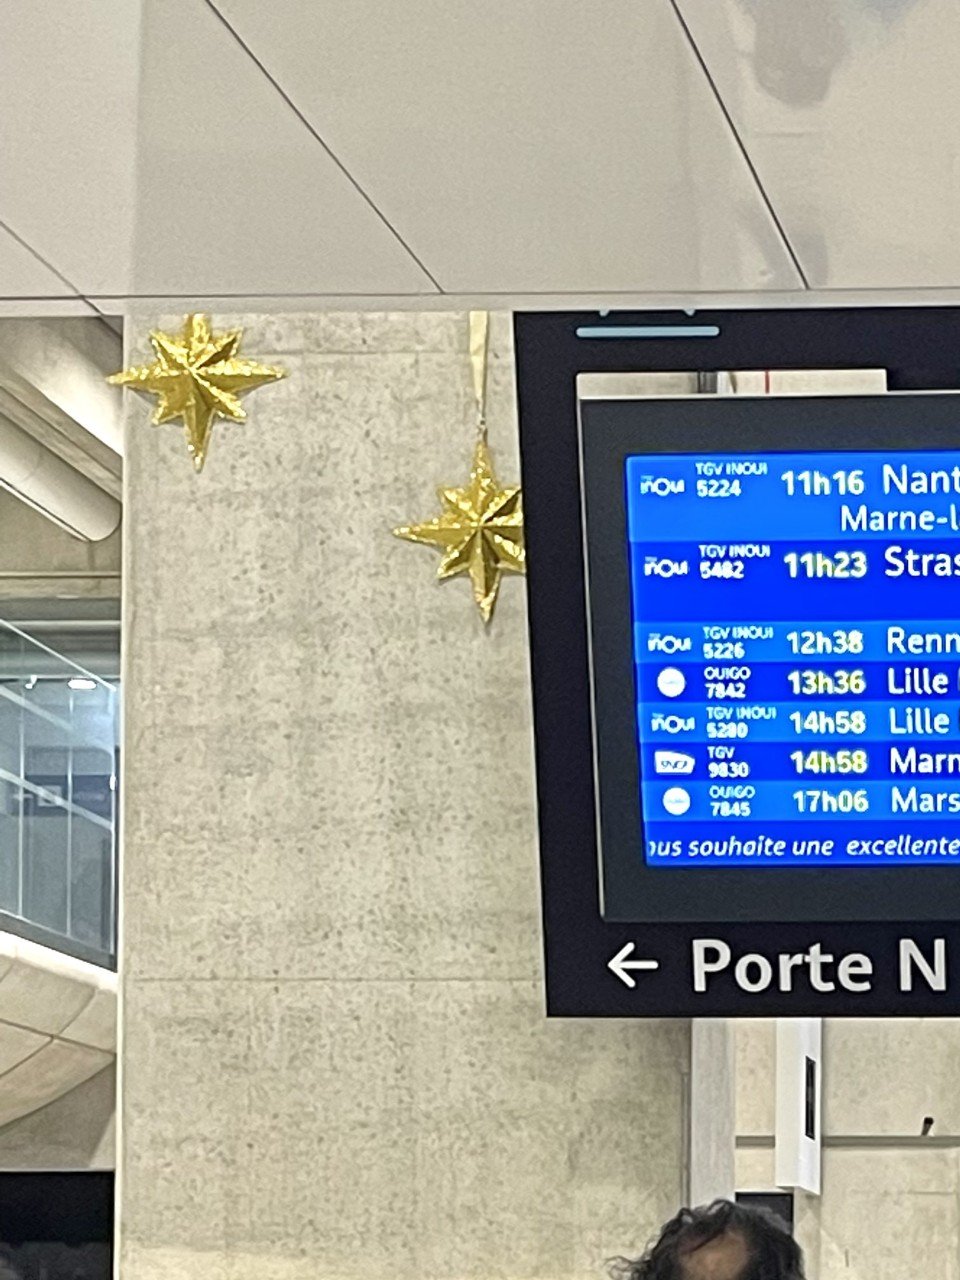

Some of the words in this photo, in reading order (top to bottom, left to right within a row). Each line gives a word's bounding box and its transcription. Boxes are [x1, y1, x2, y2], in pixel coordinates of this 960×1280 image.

[696, 462, 723, 476] TGV
[696, 480, 742, 497] 5224
[781, 470, 864, 496] 11h16
[699, 545, 726, 558] TGV
[784, 552, 867, 578] 11h23
[704, 627, 730, 640] TGV
[703, 642, 746, 659] 5226
[786, 630, 864, 655] 12h38
[703, 667, 752, 681] OUIGO
[788, 669, 866, 695] 13h36
[888, 667, 948, 695] Lille
[705, 682, 747, 699] 7842
[706, 707, 733, 720] TGV
[790, 710, 866, 735] 14h58
[890, 706, 949, 734] Lille
[707, 746, 735, 759] TGV
[790, 750, 868, 774] 14h58
[709, 785, 756, 799] OUIGO
[793, 790, 869, 812] 17h06
[792, 838, 834, 856] une
[846, 834, 960, 856] excellente
[692, 938, 874, 993] Porte
[899, 938, 948, 992] N
